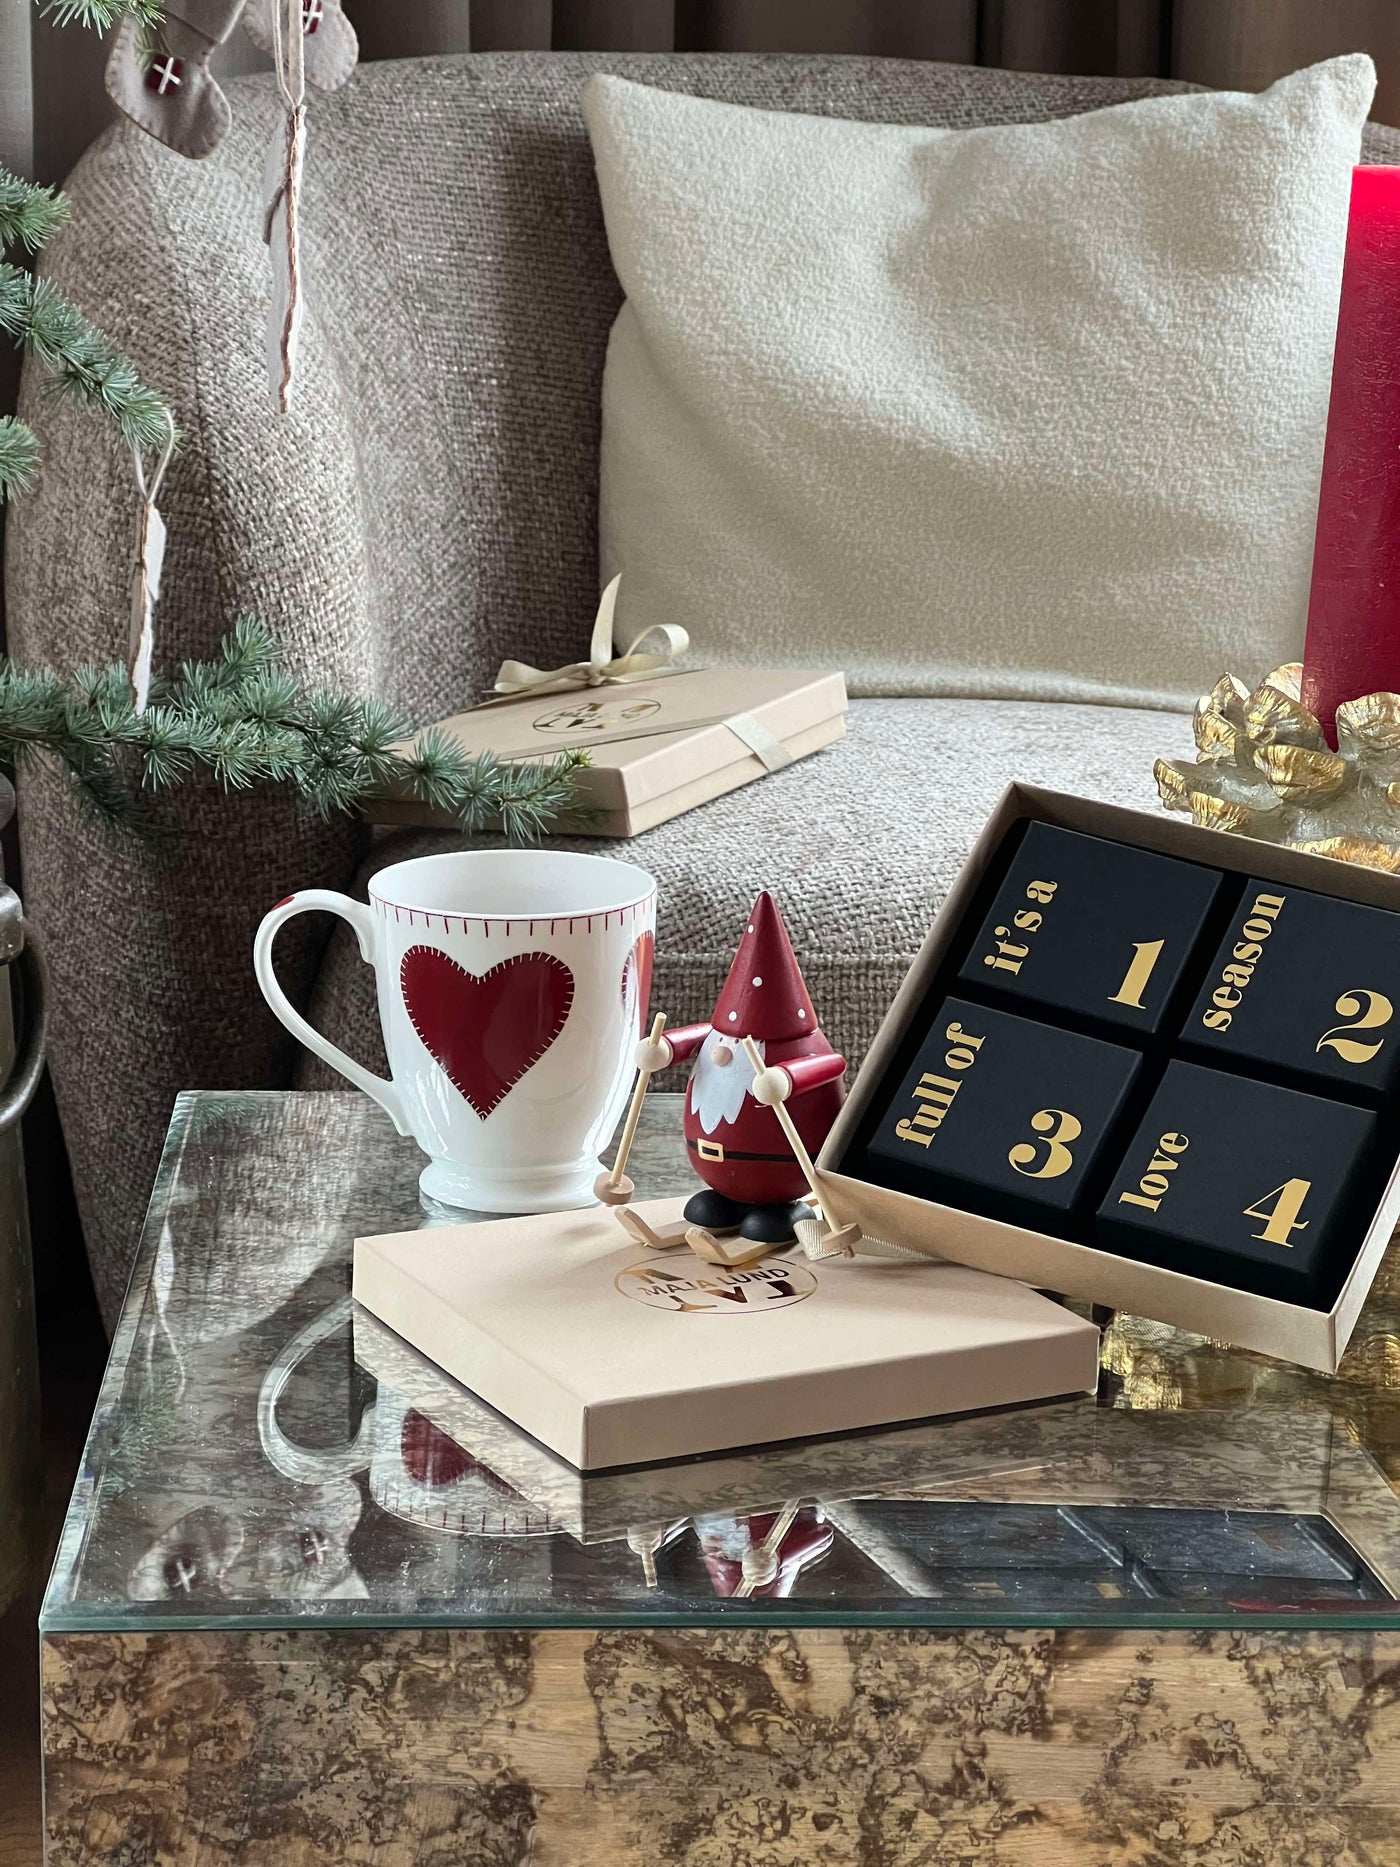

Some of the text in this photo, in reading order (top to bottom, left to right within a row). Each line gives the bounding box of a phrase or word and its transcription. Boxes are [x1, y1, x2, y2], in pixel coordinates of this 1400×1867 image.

[984, 880, 1058, 976] it's a
[1202, 892, 1286, 1033] season
[1107, 938, 1165, 1010] 1
[1316, 988, 1394, 1064] 2
[895, 1022, 986, 1149] full of
[1008, 1108, 1083, 1179] 3
[1118, 1130, 1189, 1213] love
[1242, 1177, 1311, 1248] 4
[637, 1268, 790, 1297] MAJA LUND
